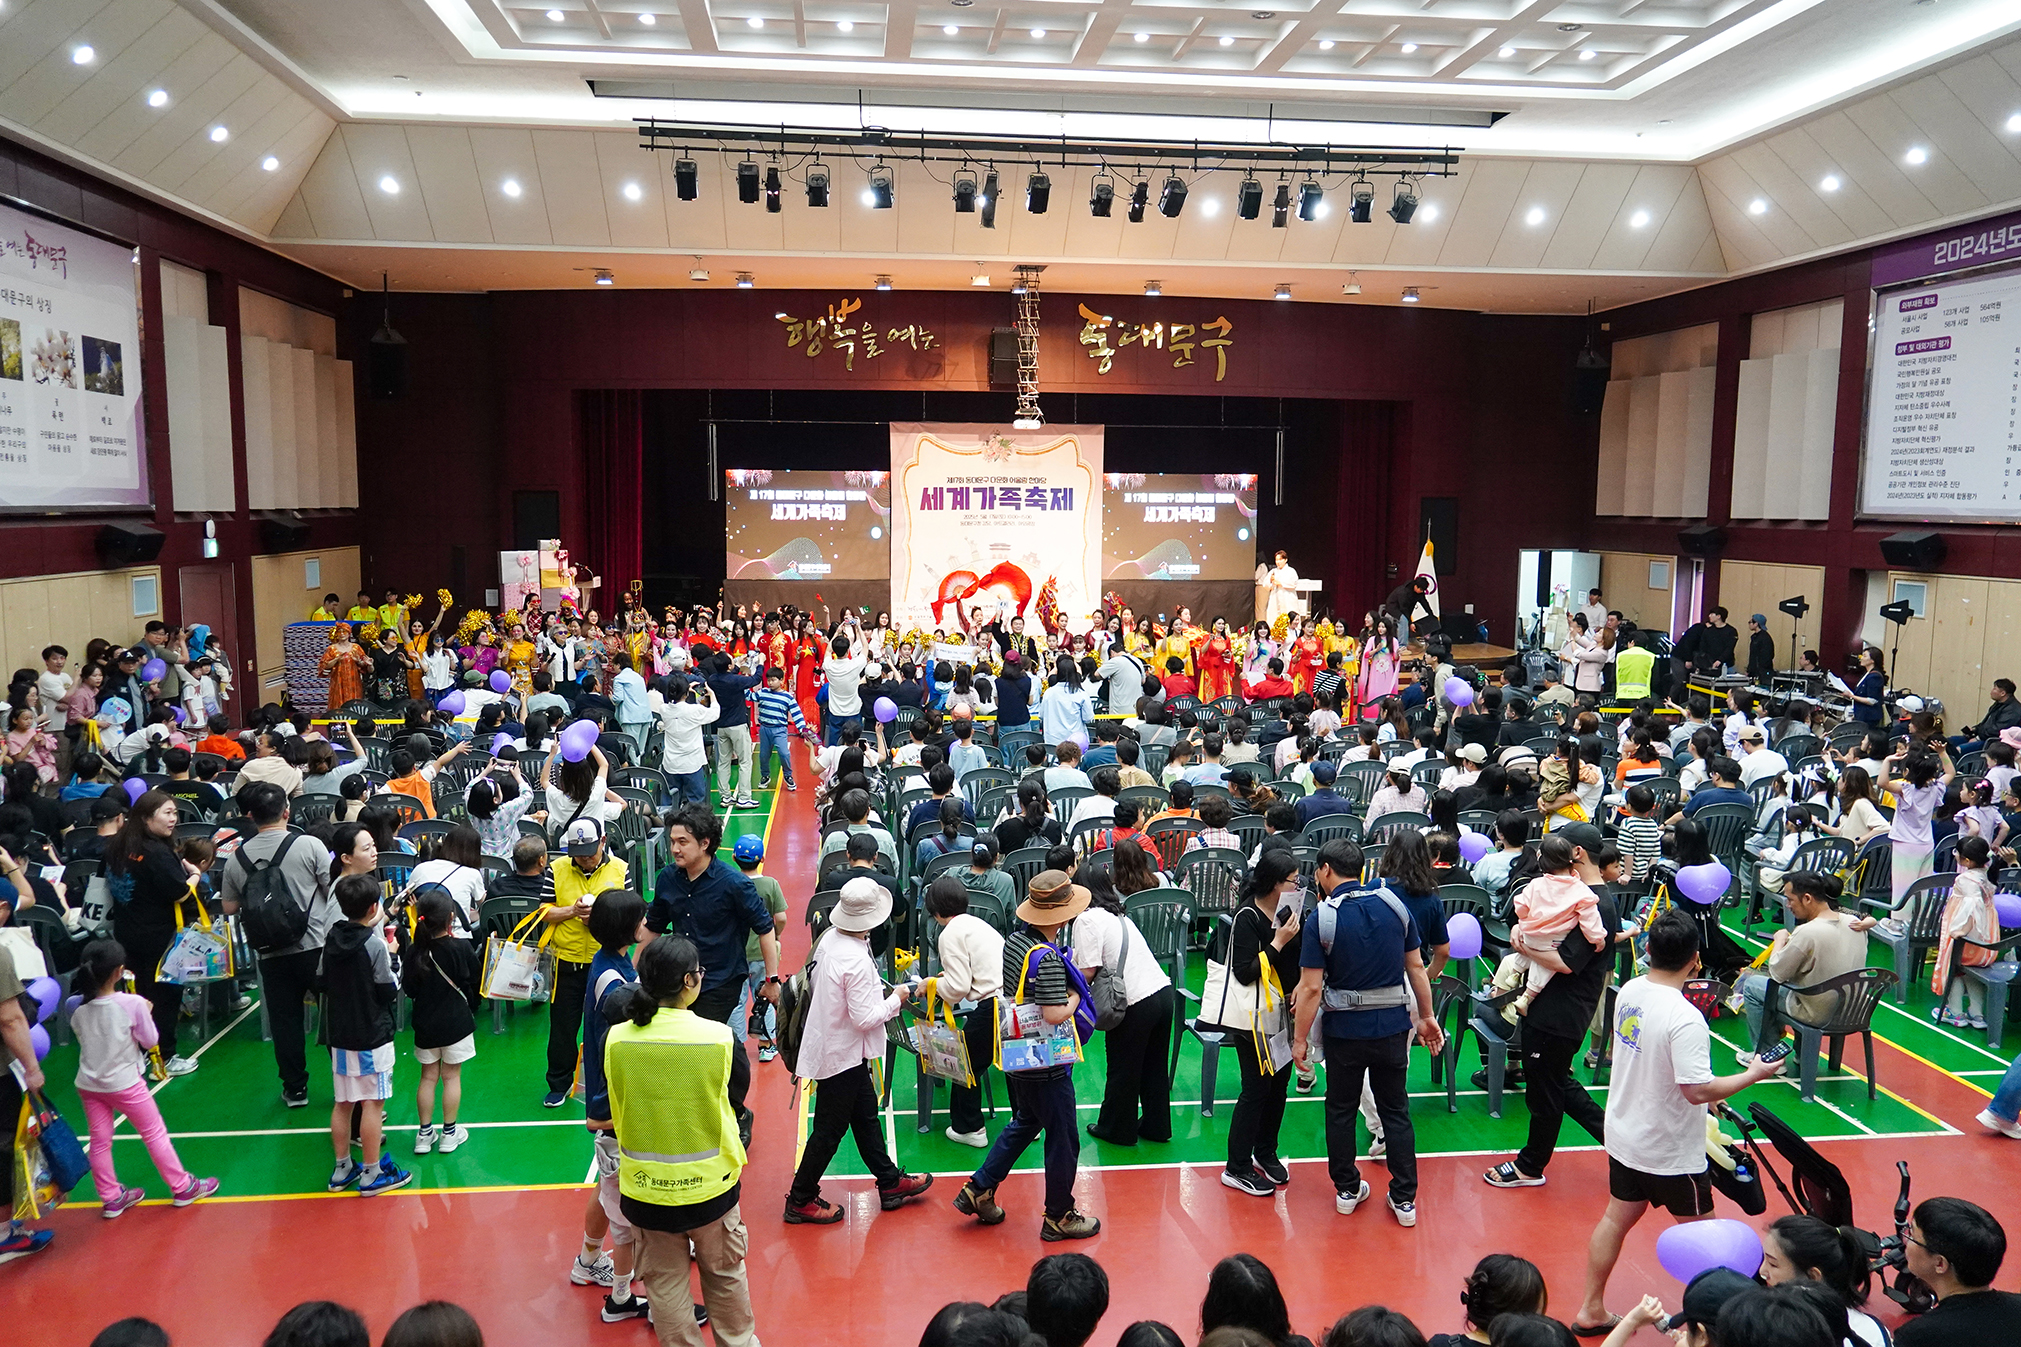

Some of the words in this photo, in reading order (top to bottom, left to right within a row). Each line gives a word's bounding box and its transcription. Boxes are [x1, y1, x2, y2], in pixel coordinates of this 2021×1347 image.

[37, 296, 52, 314] 상징
[1943, 308, 1958, 316] 123개
[1959, 306, 1970, 314] 사업
[1980, 301, 2002, 312] 564억원
[1901, 326, 1920, 335] 공모사업
[1958, 318, 1968, 326] 사업
[1980, 314, 2000, 324] 105억원
[775, 297, 884, 372] 행복을
[887, 322, 940, 351] 여는
[1078, 302, 1233, 382] 동대문구
[1898, 358, 1916, 366] 대한민국
[1895, 392, 1914, 400] 대한민국
[920, 486, 1074, 510] 세계가족축제
[651, 1176, 702, 1187] 동대문구가족센터
